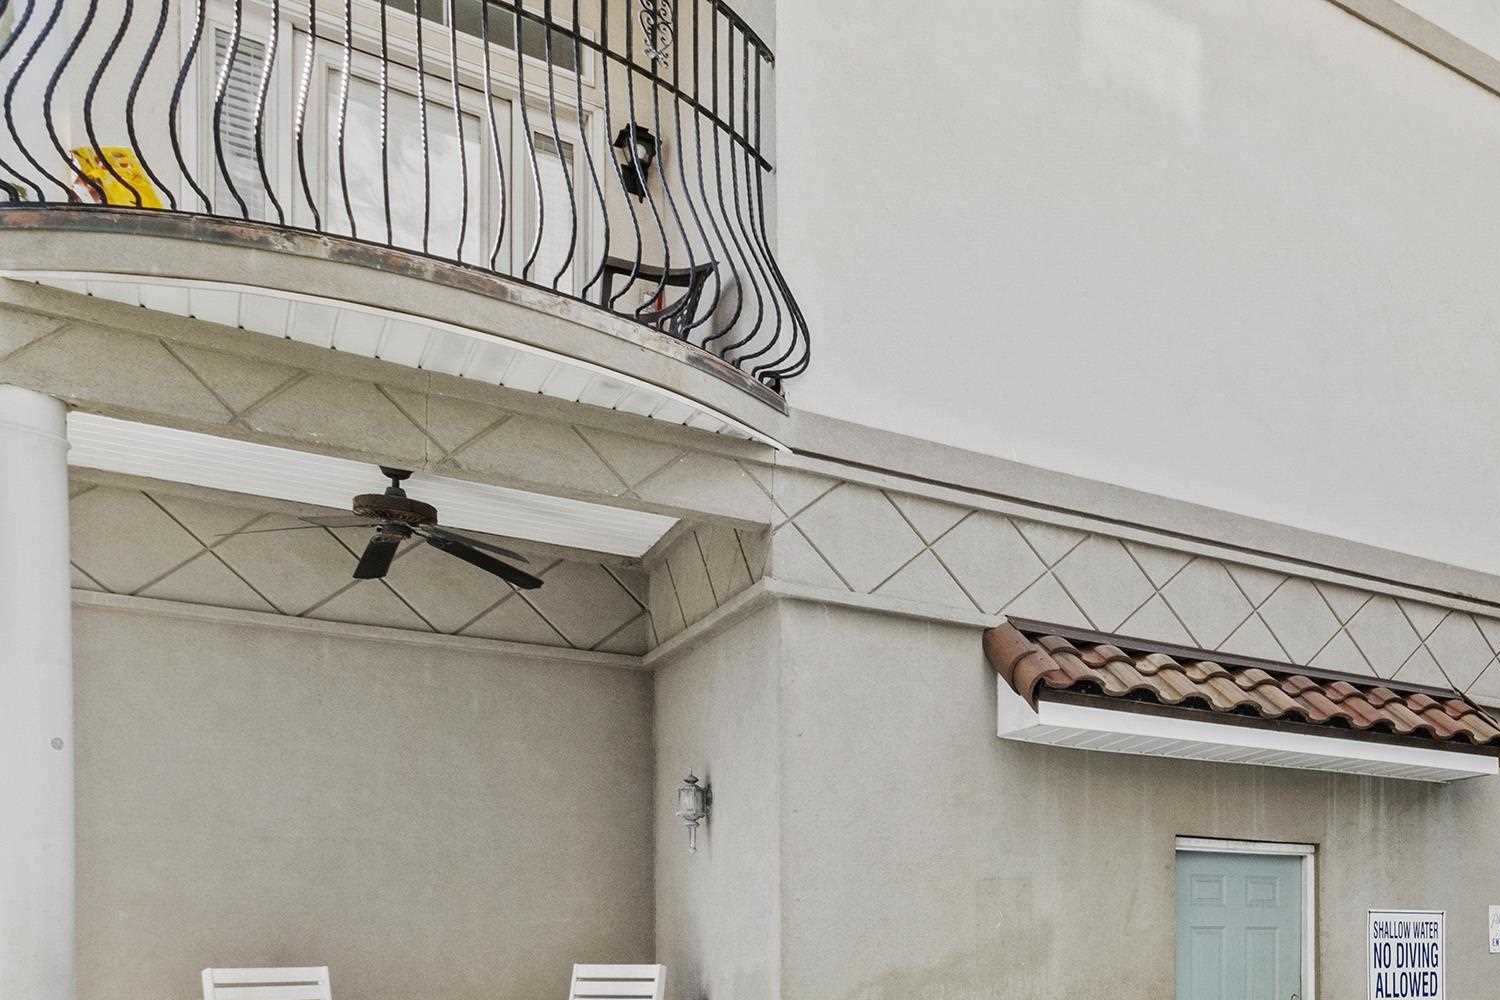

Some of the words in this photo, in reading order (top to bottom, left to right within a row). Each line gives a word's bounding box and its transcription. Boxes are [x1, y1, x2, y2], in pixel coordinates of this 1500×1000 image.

[1373, 920, 1411, 939] SHALLOW
[1413, 920, 1439, 939] WATER
[1373, 942, 1392, 969] NO
[1396, 942, 1439, 969] DIVING
[1375, 971, 1438, 998] ALLOWED
